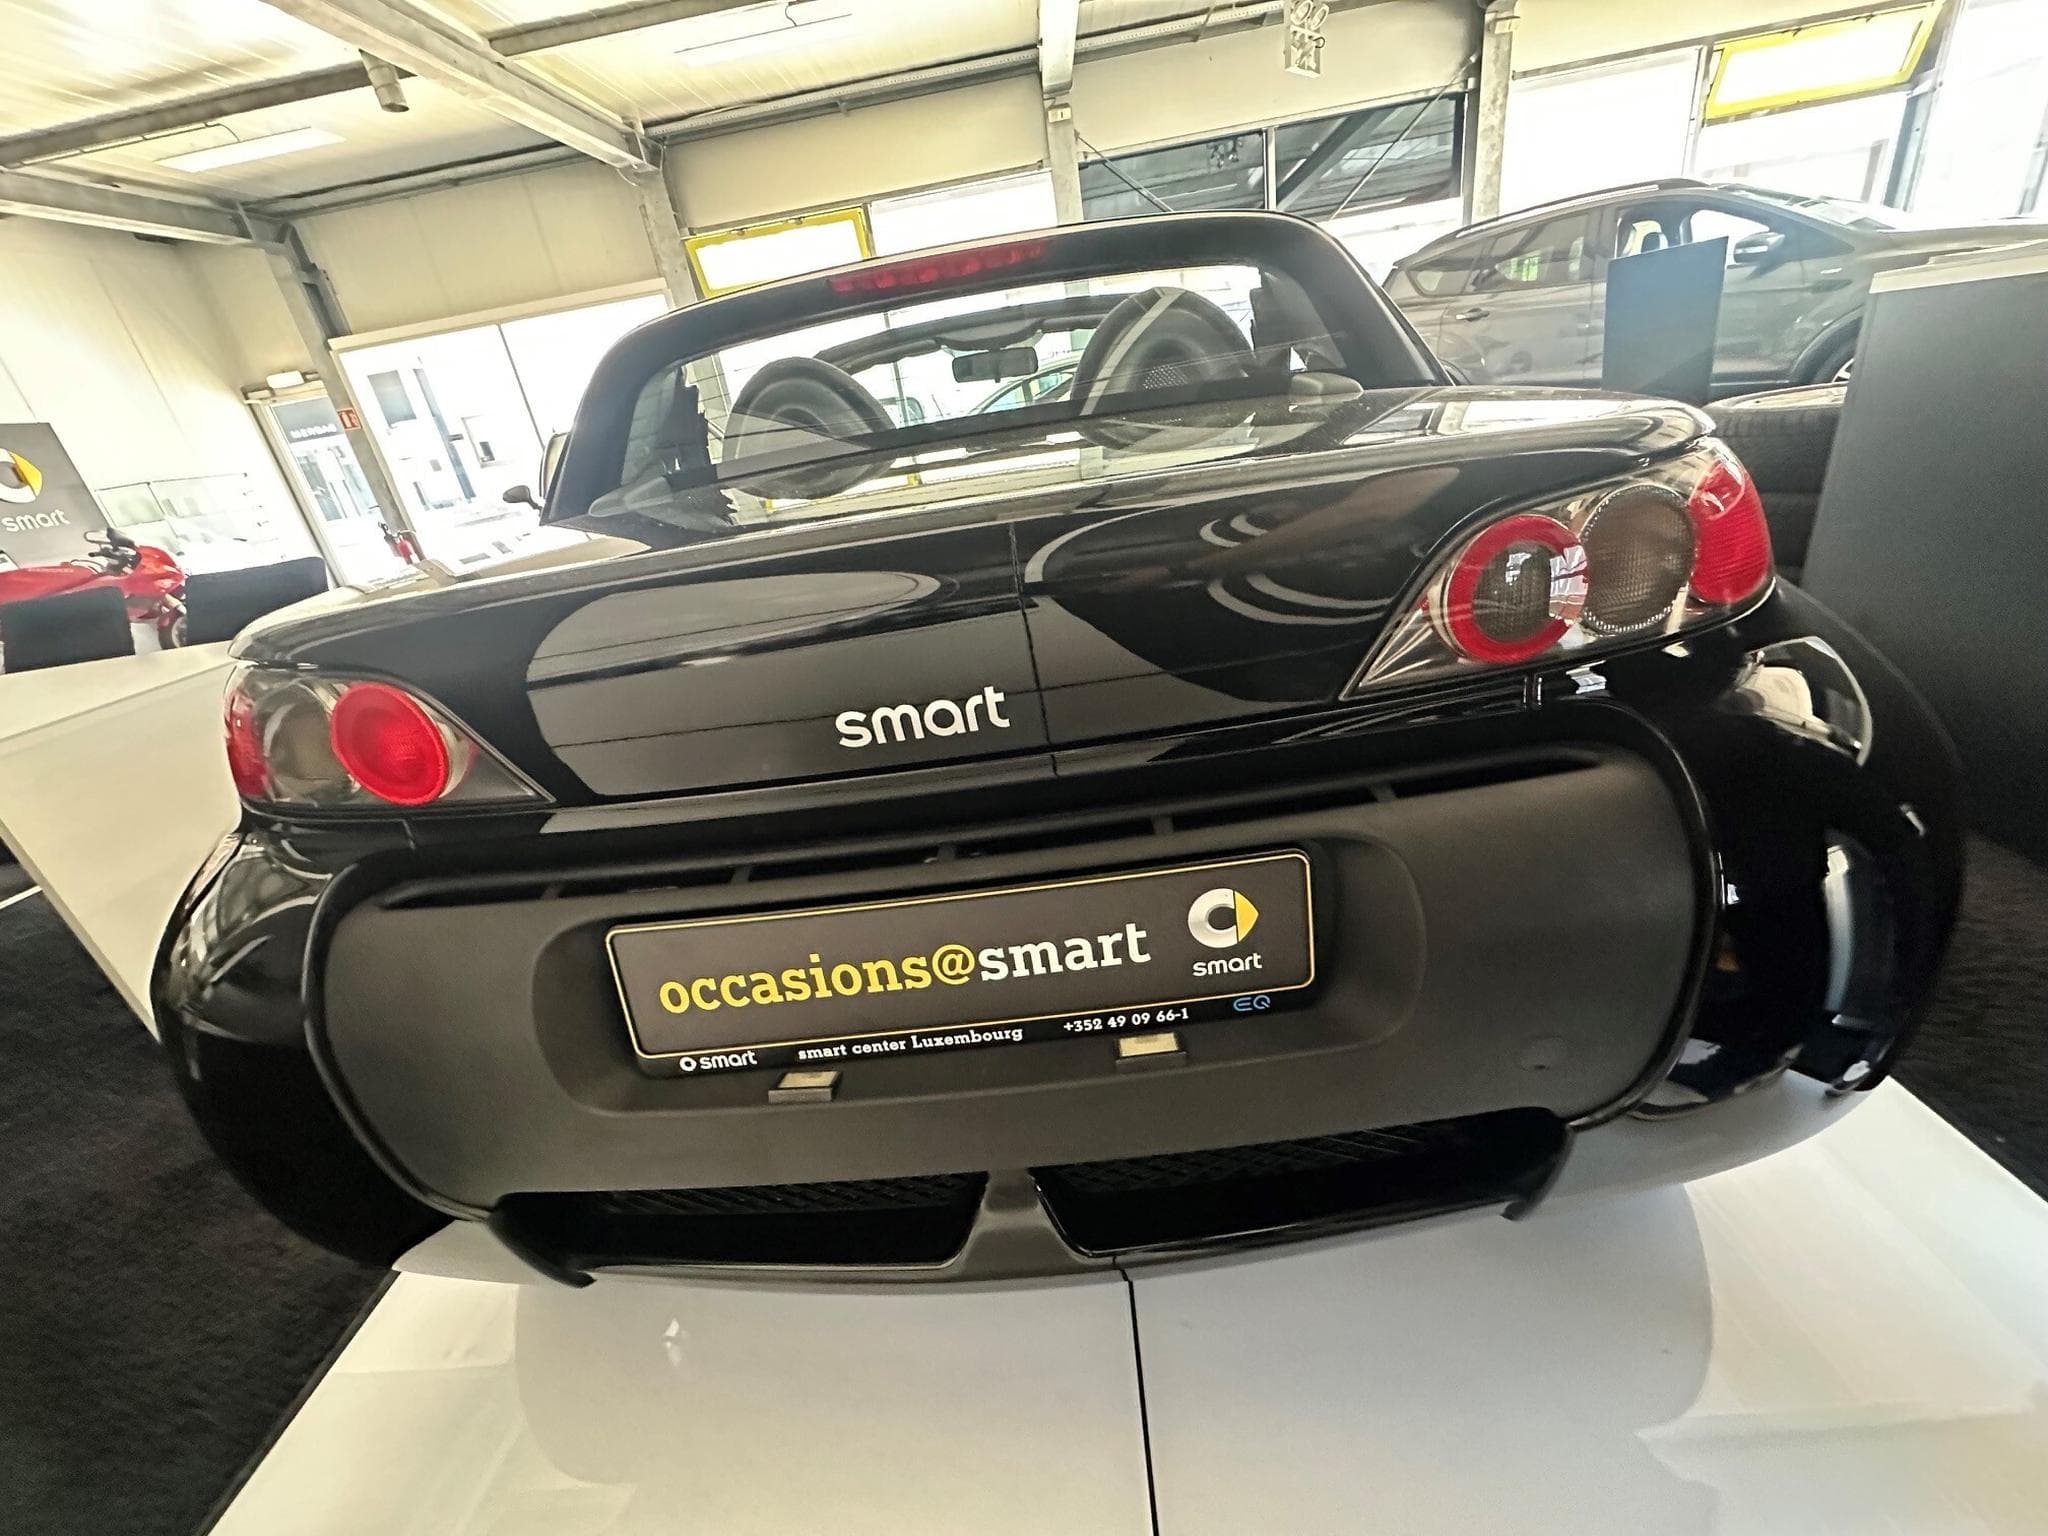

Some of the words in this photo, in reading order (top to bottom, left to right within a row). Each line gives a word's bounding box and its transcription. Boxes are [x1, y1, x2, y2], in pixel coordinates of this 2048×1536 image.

[1, 509, 71, 532] smart
[835, 683, 1011, 748] smart
[659, 922, 1152, 1014] occasions@smart
[1192, 952, 1263, 977] smart
[1232, 994, 1272, 1012] EQ
[1063, 1017, 1103, 1033] +352
[1106, 1015, 1127, 1029] 49
[1131, 1012, 1151, 1026] 09
[1155, 1007, 1189, 1023] 66-1
[797, 1044, 848, 1061] smart
[851, 1038, 907, 1055] center
[910, 1028, 1024, 1049] Luxembourg
[700, 1050, 758, 1070] smart
